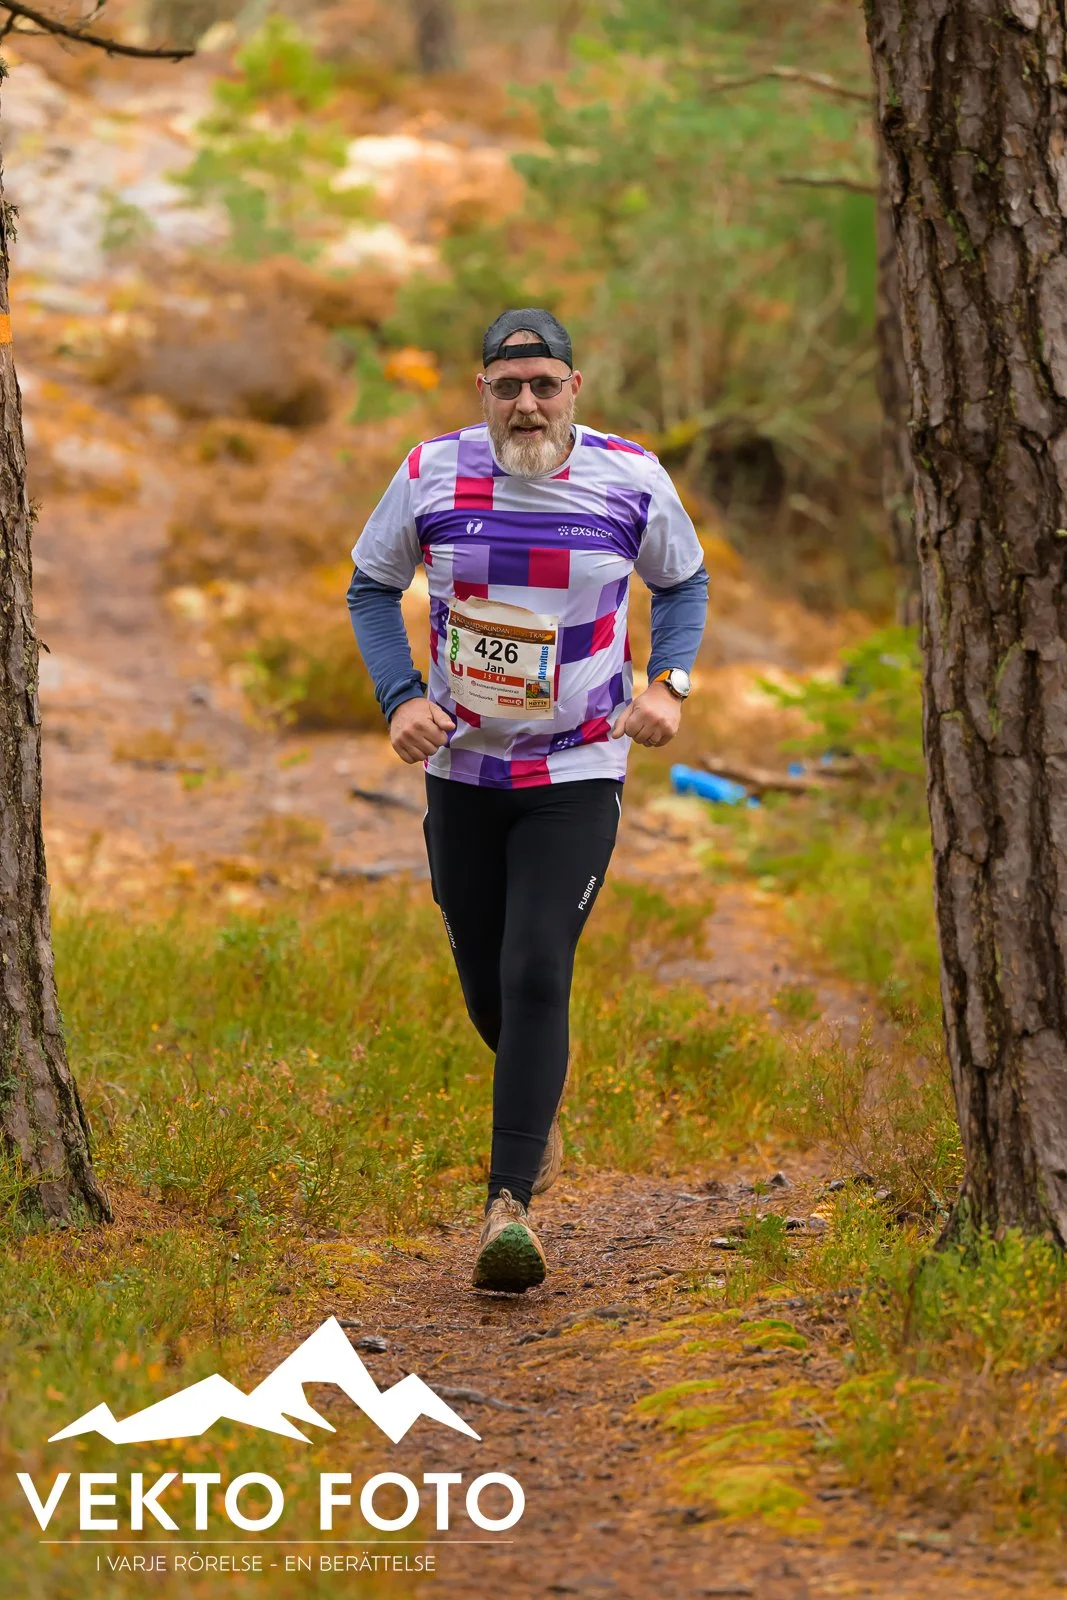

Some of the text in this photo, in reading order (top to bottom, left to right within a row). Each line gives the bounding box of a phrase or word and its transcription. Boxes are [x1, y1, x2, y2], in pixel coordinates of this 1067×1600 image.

[474, 637, 519, 664] 426
[538, 645, 549, 680] Aktivitus
[485, 662, 505, 674] Jan
[496, 675, 506, 683] KM
[578, 875, 597, 910] FUSION
